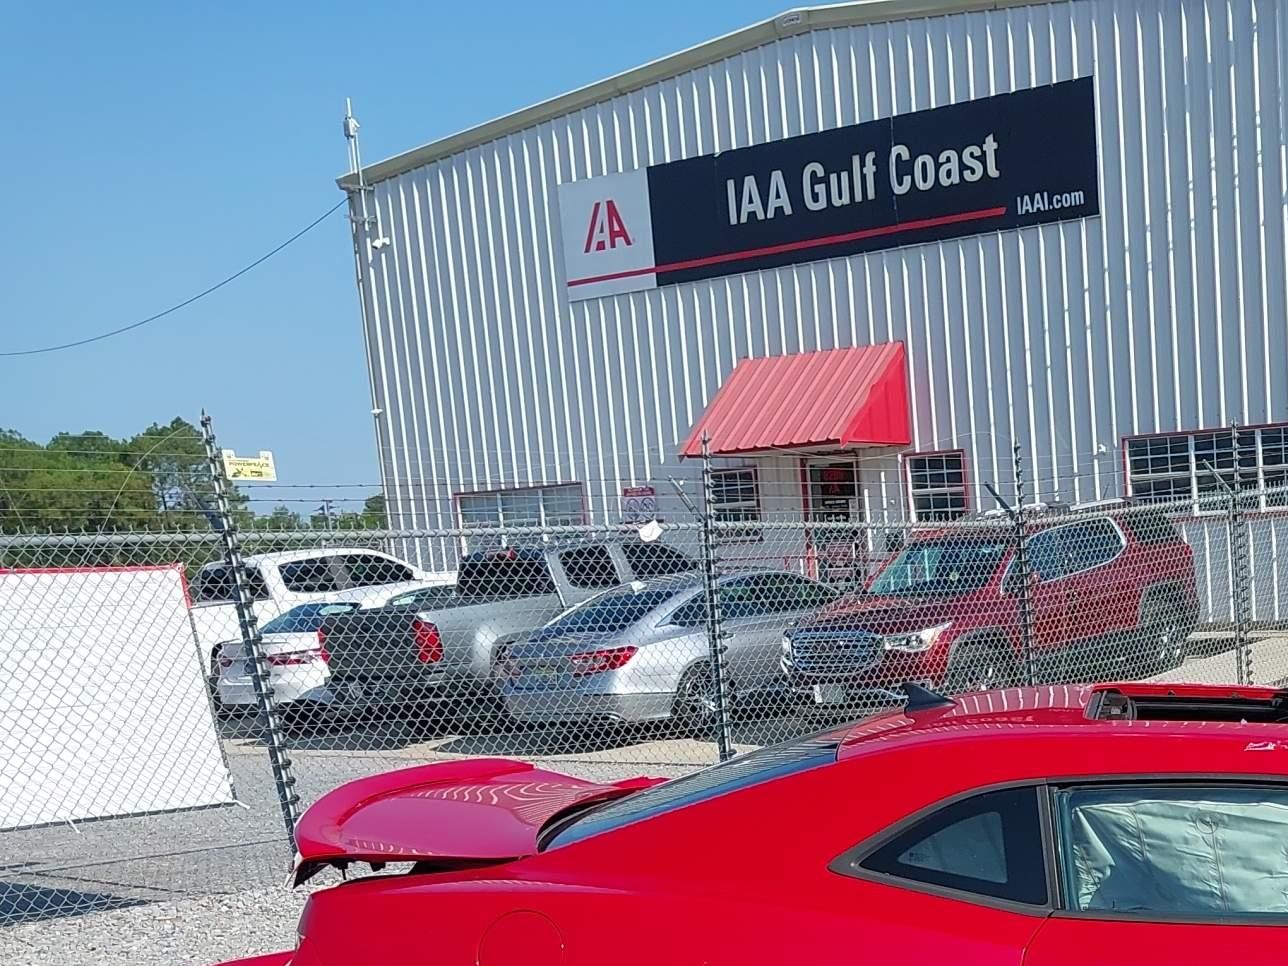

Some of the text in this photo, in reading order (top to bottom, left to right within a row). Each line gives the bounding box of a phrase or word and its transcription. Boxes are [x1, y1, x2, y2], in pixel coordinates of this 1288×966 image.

[727, 132, 1000, 226] IAA Gulf Coast
[1016, 190, 1085, 215] IAAI.com
